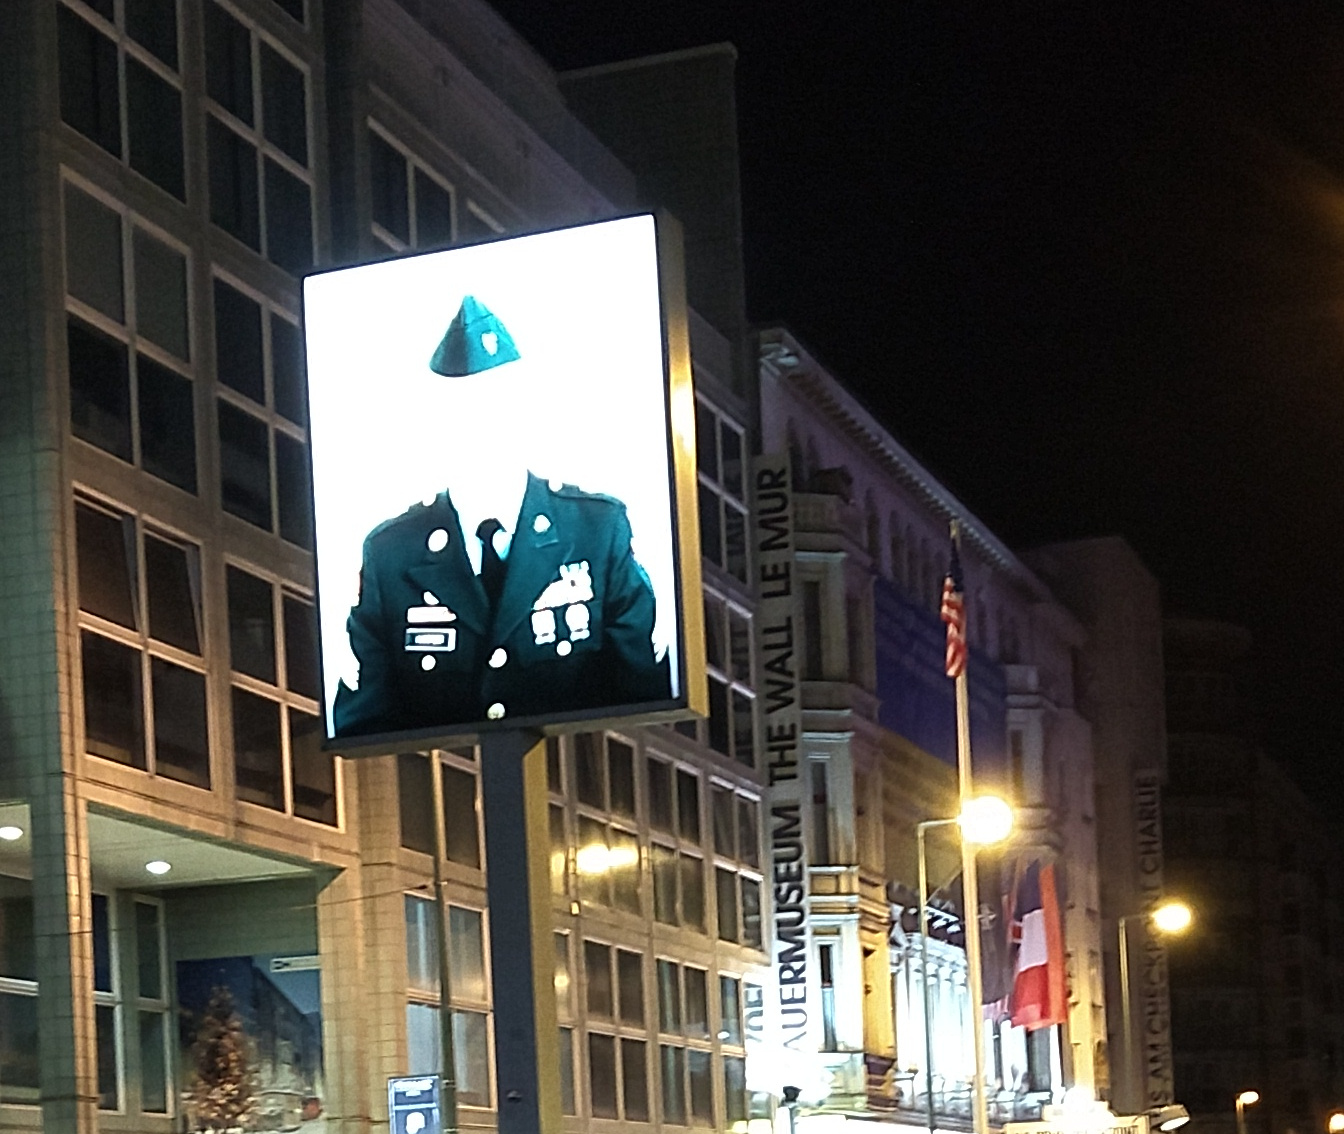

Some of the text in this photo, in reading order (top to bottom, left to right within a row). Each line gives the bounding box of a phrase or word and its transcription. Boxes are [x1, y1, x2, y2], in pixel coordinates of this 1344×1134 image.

[757, 468, 808, 1054] AUERMUSEUM THE WALL LE MUR
[1141, 885, 1168, 1035] CHECKPNT
